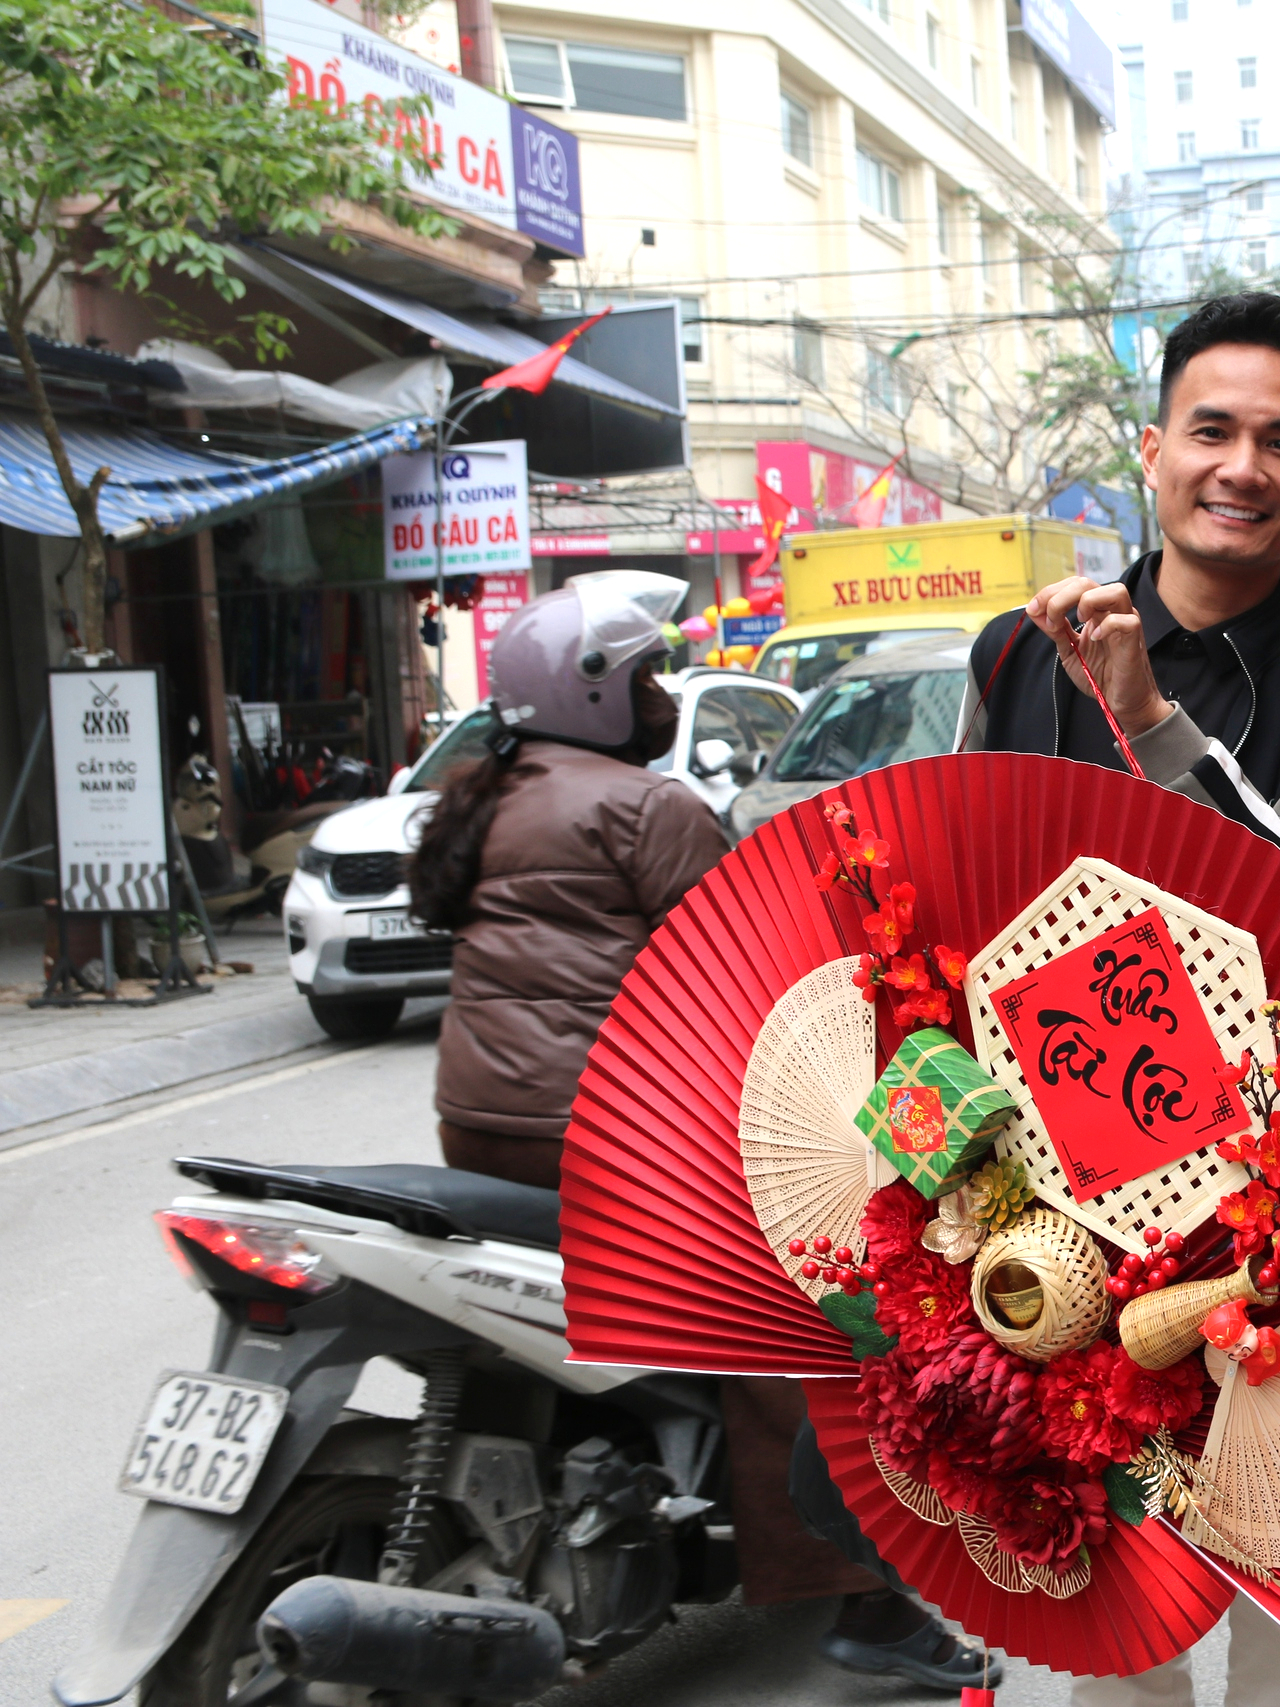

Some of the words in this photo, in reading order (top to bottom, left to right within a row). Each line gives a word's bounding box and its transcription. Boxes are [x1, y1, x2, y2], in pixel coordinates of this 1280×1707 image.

[342, 33, 400, 82] KHÁNH
[404, 67, 456, 109] QUỲNH
[833, 579, 862, 608] XE
[866, 574, 911, 605] BƯU
[916, 564, 983, 600] CHÍNH
[80, 780, 113, 792] NAM
[108, 758, 138, 775] TÓC
[1088, 949, 1179, 1036] Xuân
[163, 1380, 262, 1444] 37-B2
[128, 1433, 250, 1502] 548.62
